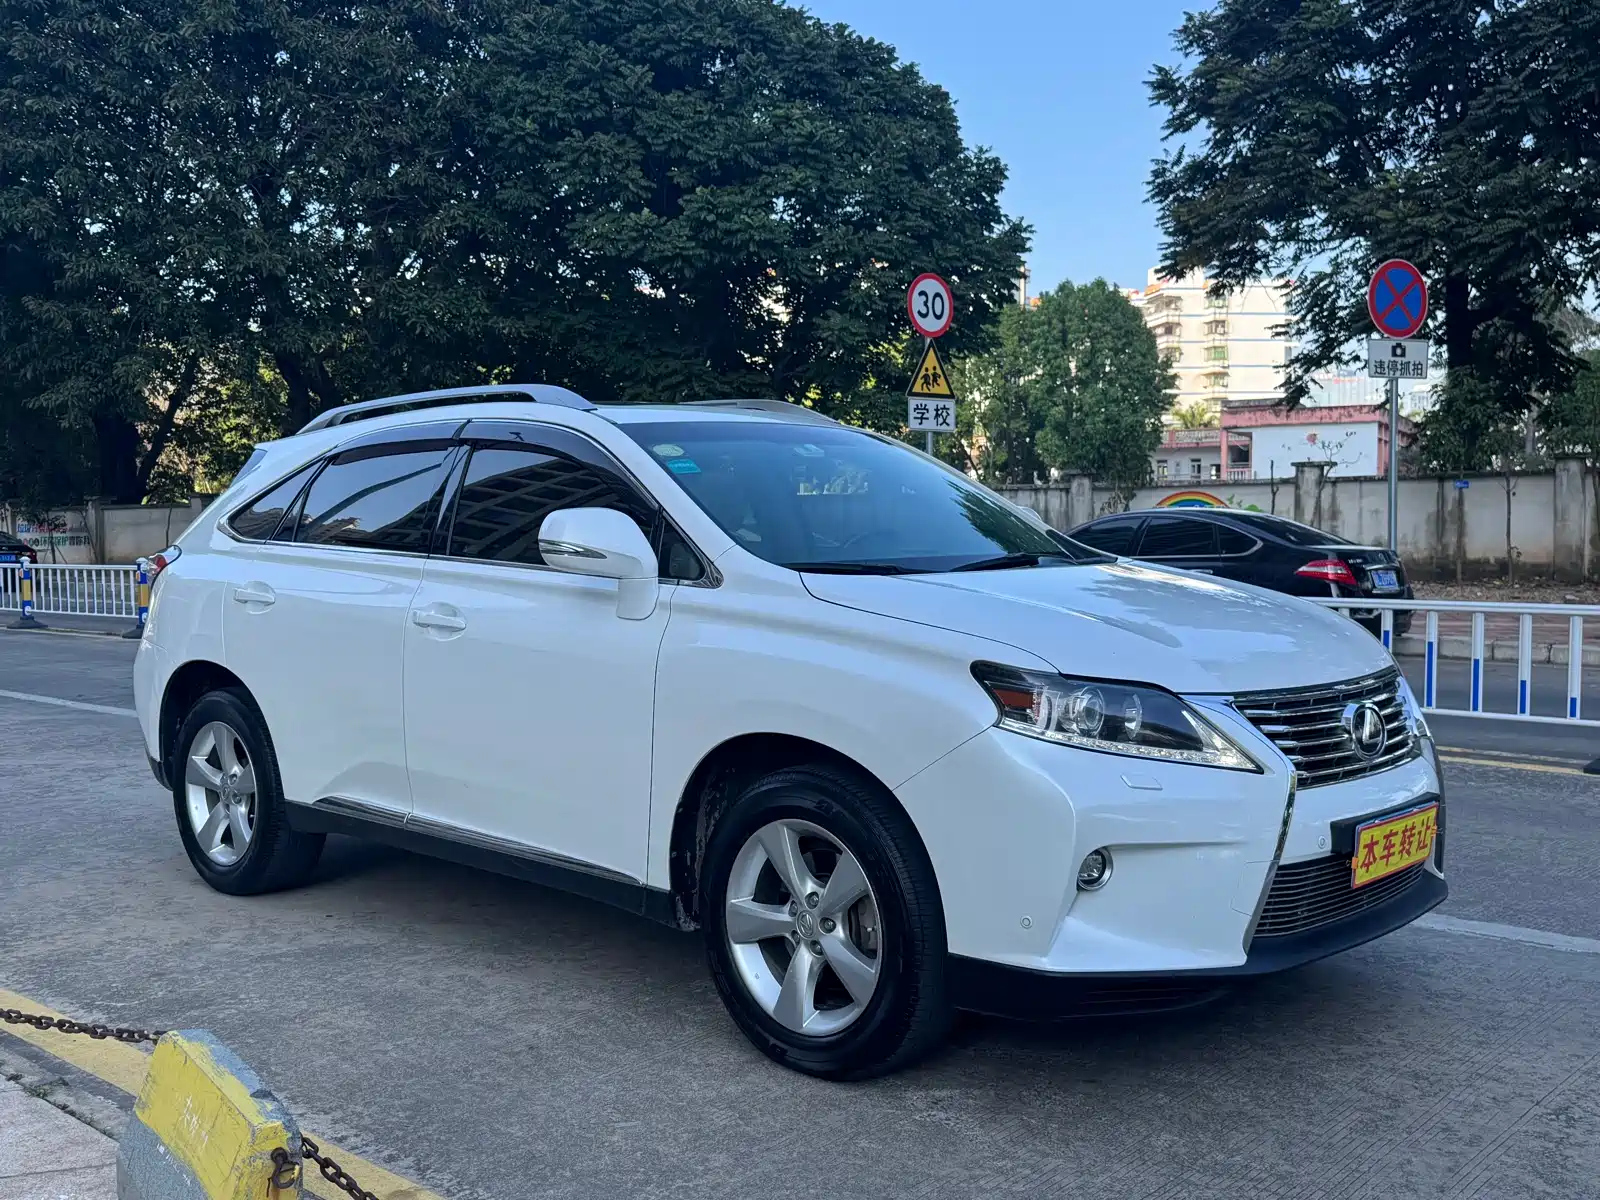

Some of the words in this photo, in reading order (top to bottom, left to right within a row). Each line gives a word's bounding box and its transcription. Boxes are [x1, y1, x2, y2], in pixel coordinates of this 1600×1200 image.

[917, 290, 944, 320] 30
[1373, 360, 1423, 377] 违停抓拍
[913, 402, 950, 427] 学校
[1360, 816, 1431, 873] 本车转让
